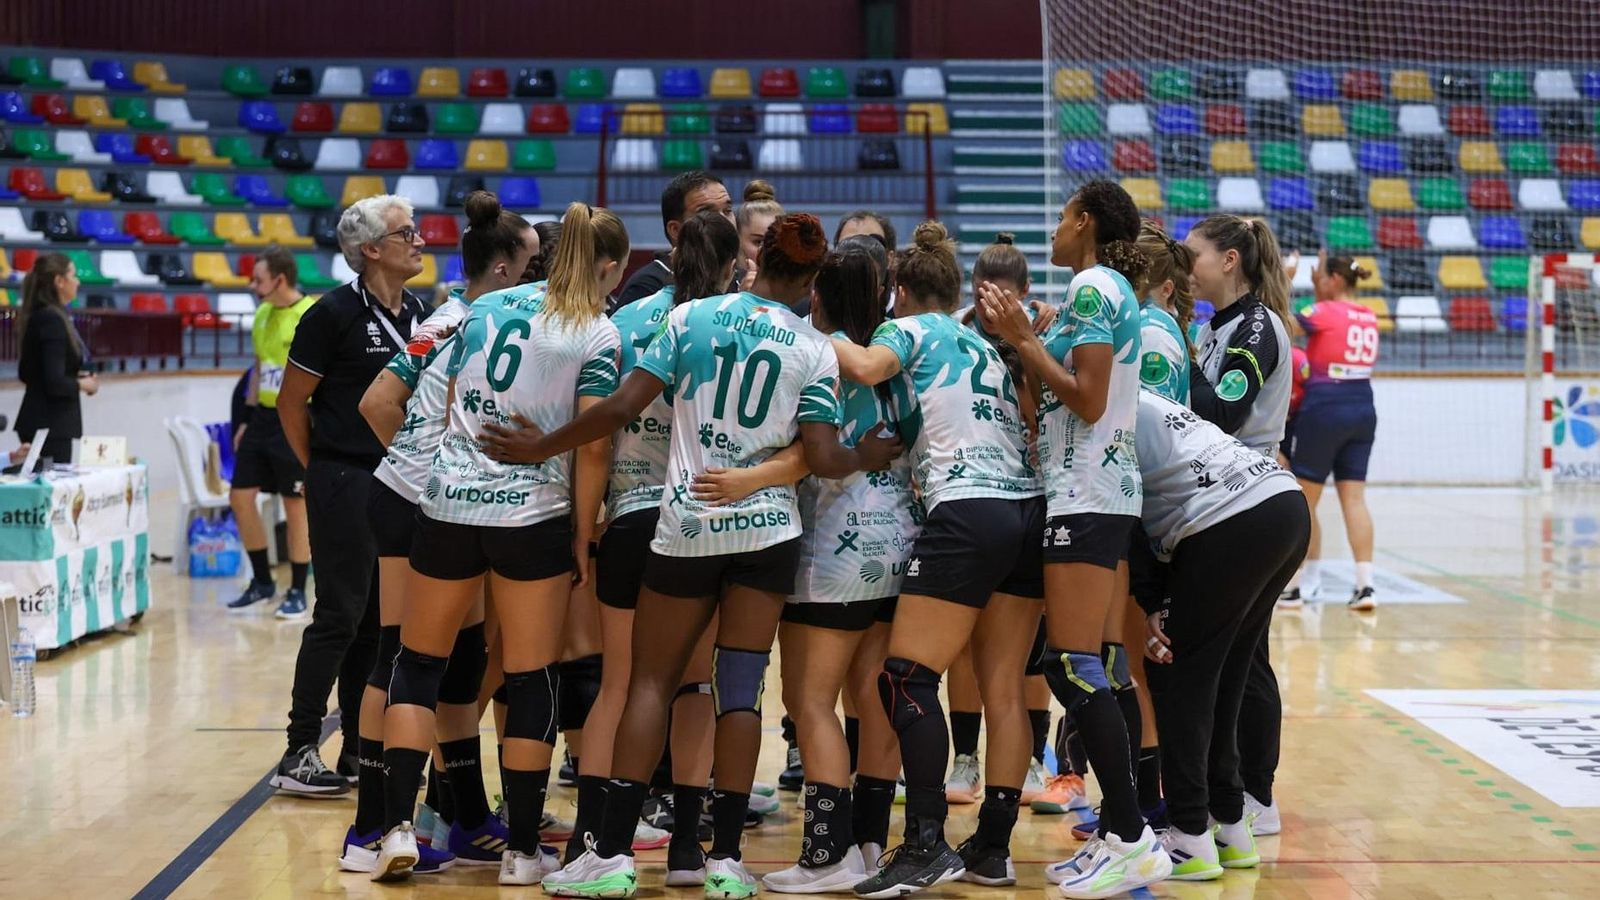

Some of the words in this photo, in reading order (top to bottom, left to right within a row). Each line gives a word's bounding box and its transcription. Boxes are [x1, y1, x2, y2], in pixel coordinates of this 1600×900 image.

[713, 311, 731, 326] SO
[734, 319, 797, 347] DELGADO
[1344, 324, 1377, 364] 99
[486, 318, 531, 392] 6
[713, 341, 781, 429] 10
[444, 485, 530, 505] urbaser
